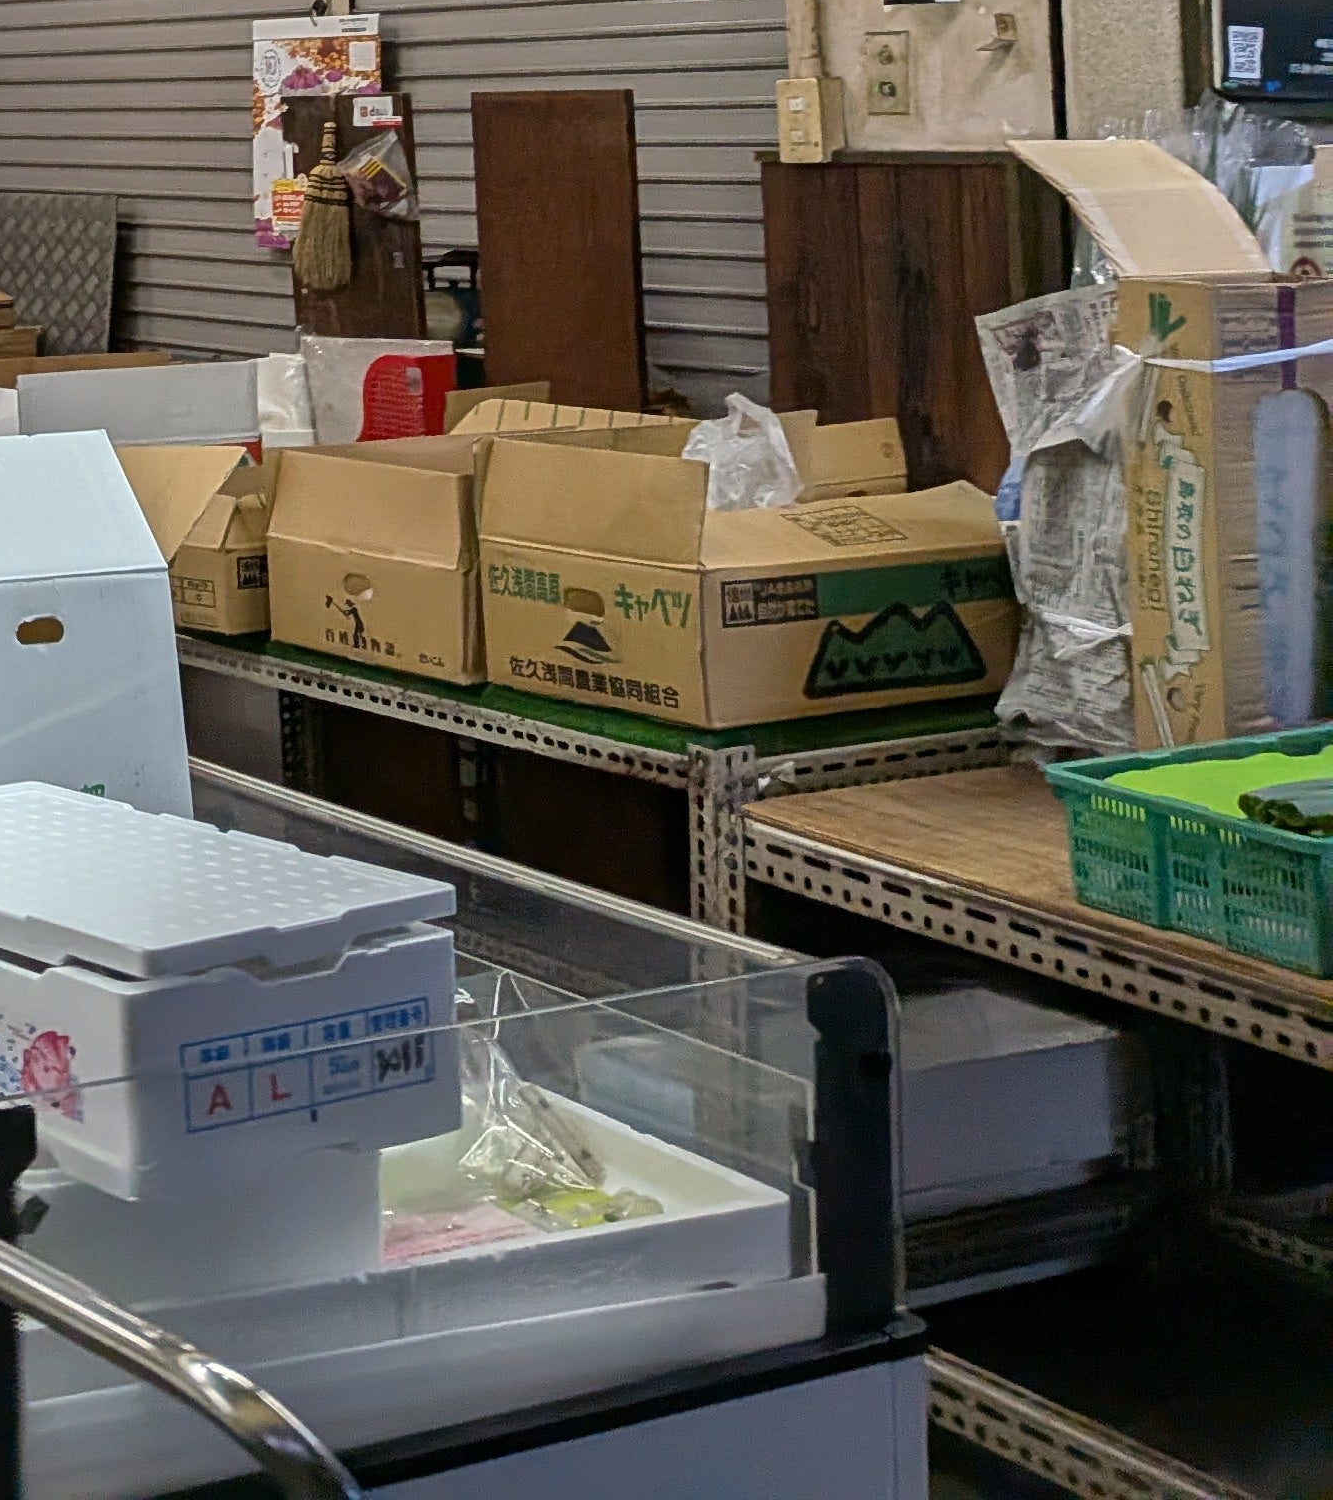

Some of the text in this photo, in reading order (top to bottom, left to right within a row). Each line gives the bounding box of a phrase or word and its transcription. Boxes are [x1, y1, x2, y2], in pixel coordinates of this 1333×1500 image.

[614, 583, 692, 628] キャベツ
[208, 1073, 293, 1116] A L
